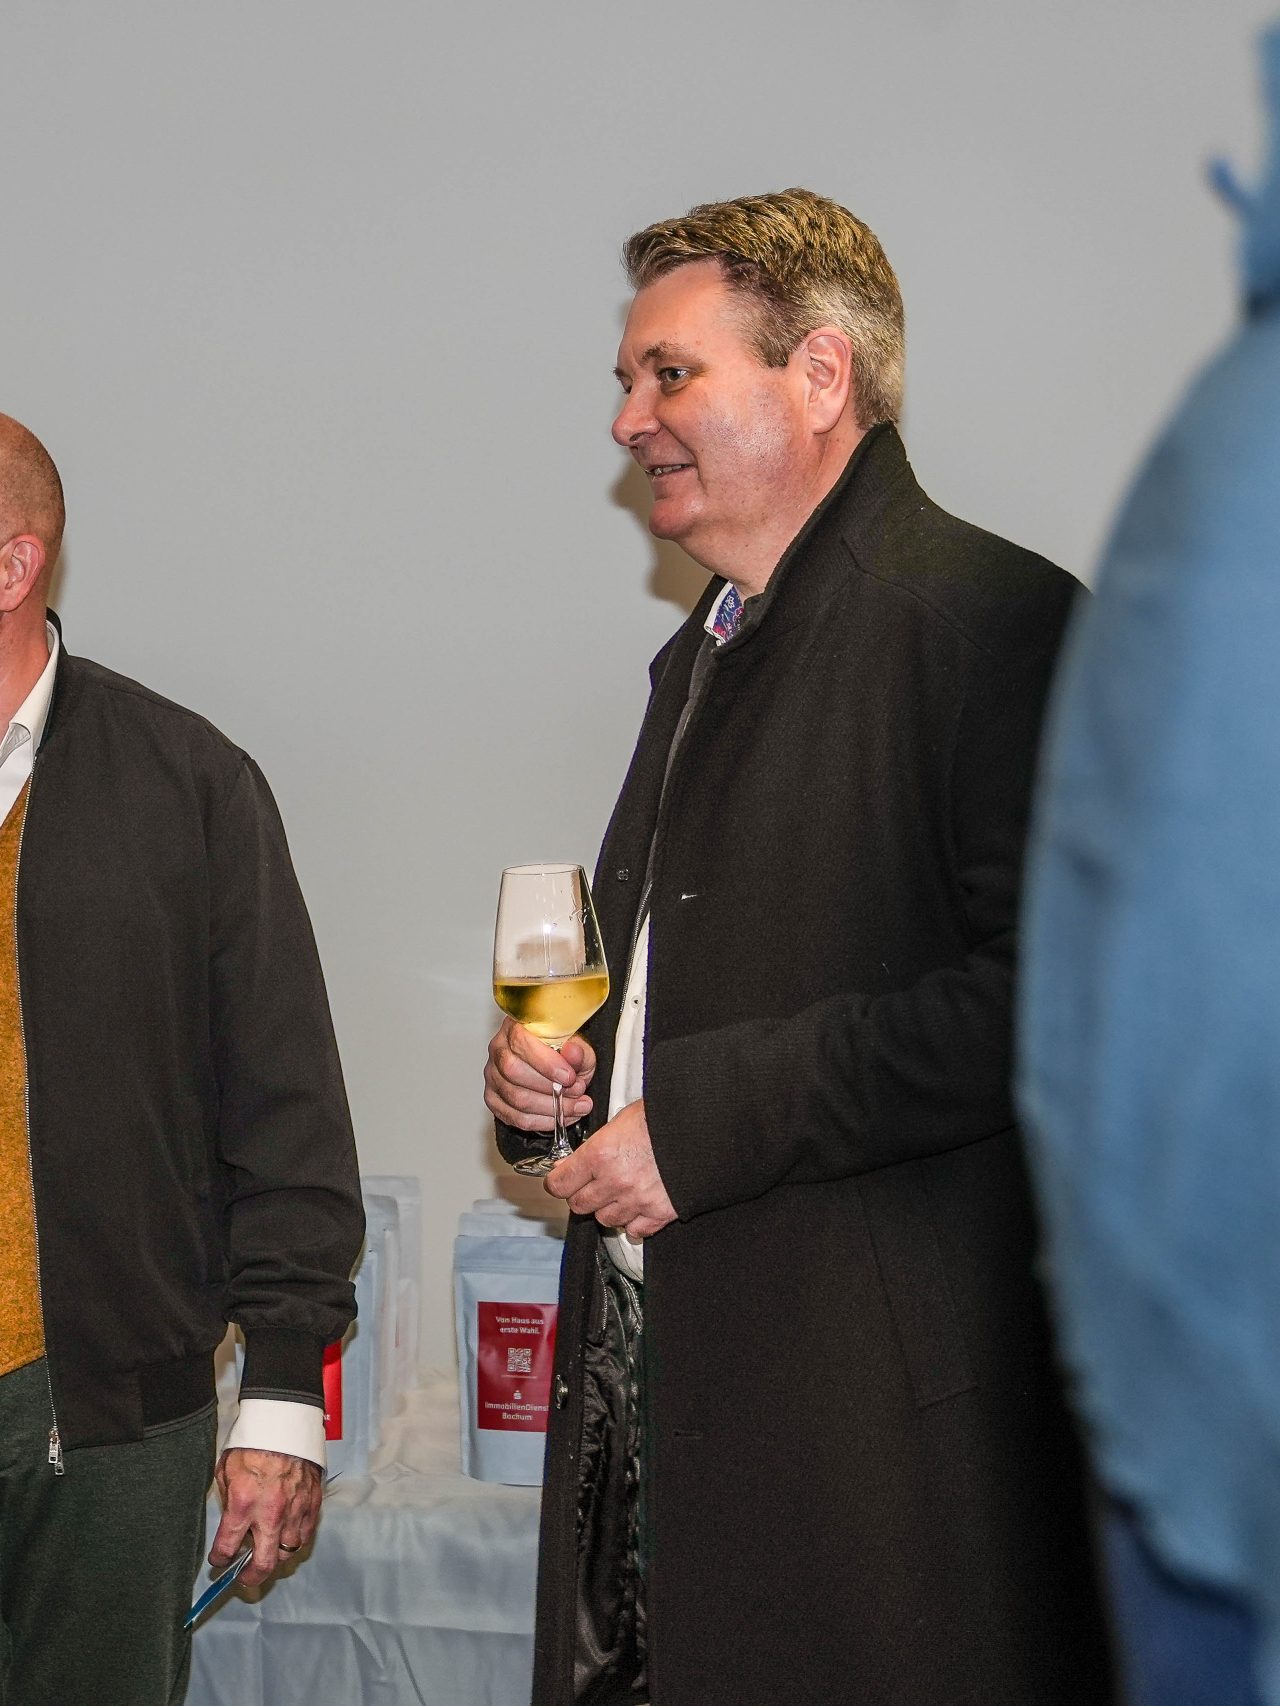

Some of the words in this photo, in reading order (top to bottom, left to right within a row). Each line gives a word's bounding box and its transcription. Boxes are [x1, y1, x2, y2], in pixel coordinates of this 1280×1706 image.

[495, 1316, 510, 1324] Von
[511, 1317, 530, 1325] Haus
[500, 1326, 518, 1334] erste
[519, 1326, 540, 1335] Wahl.
[502, 1412, 533, 1421] Bochum
